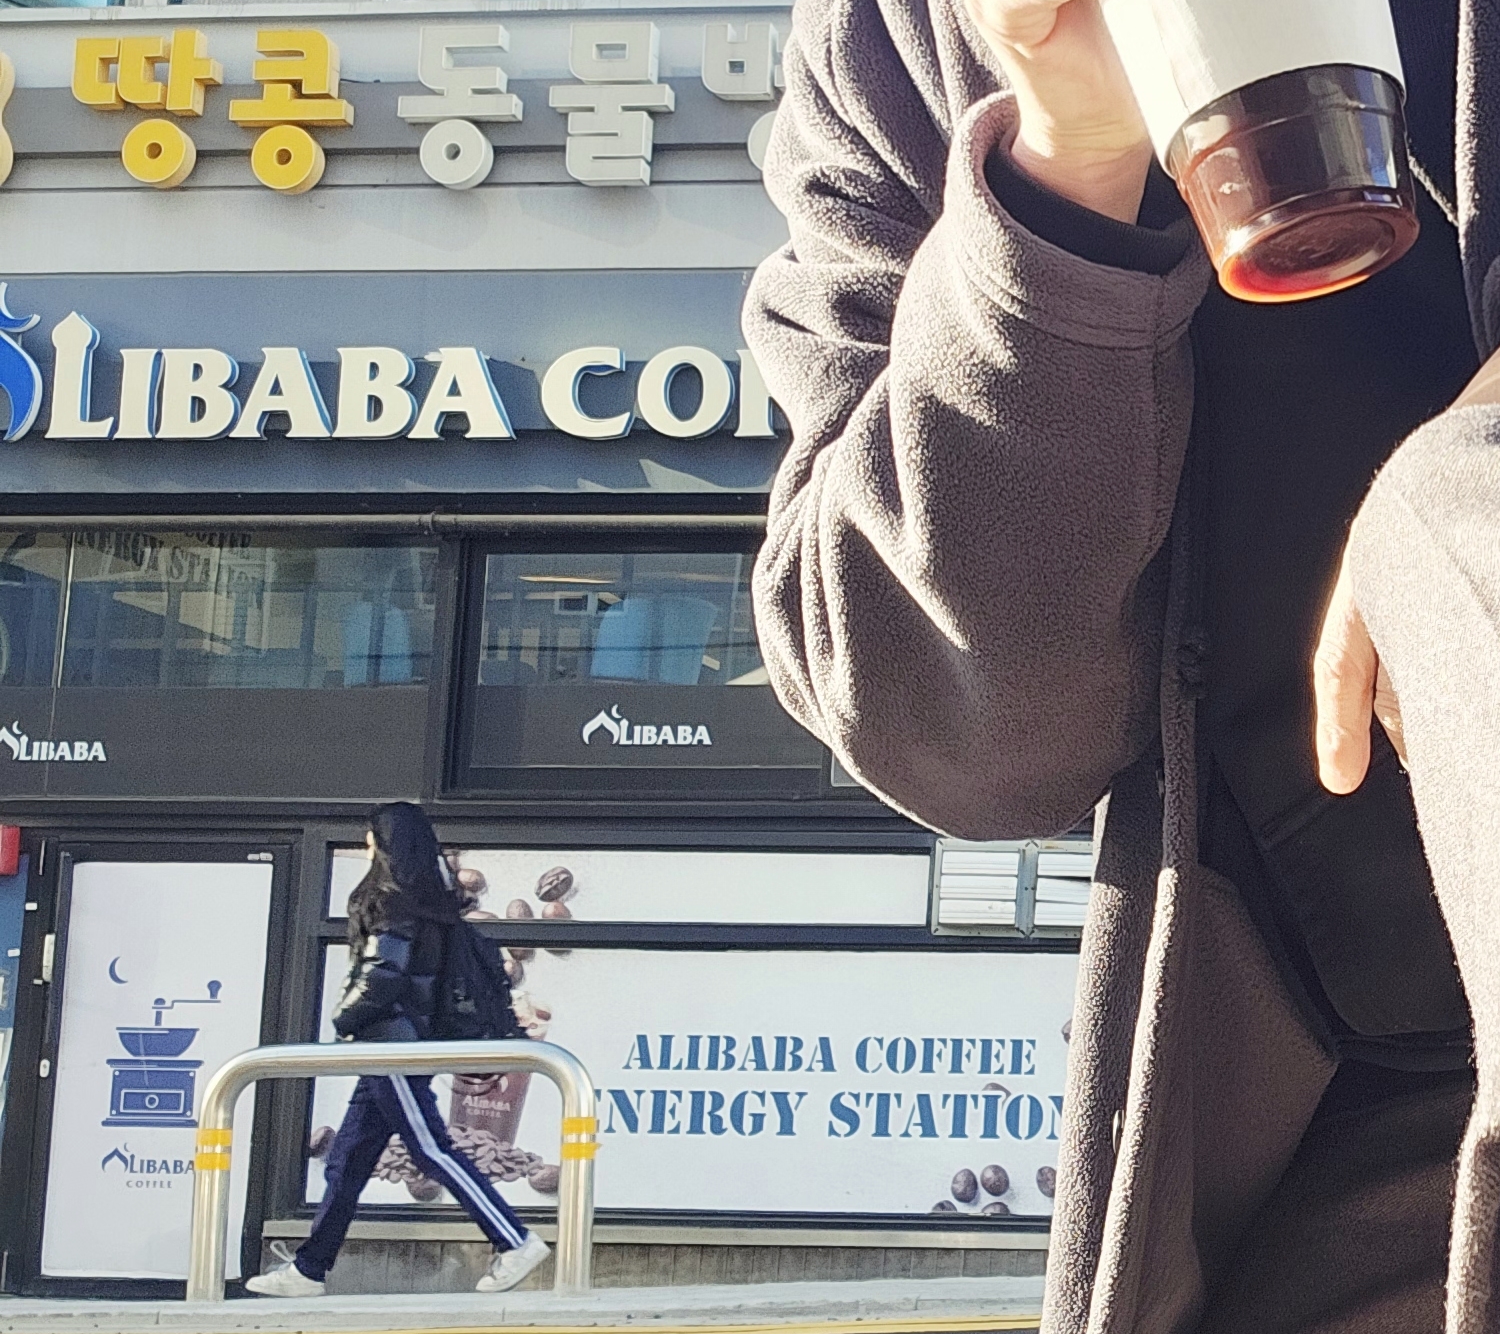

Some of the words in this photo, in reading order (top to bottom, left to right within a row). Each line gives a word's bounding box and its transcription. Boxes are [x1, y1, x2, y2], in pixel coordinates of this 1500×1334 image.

[71, 29, 355, 195] 땅콩
[622, 1033, 838, 1073] ALIBABA
[855, 1036, 1037, 1076] COFFEE
[594, 1088, 809, 1137] NERGY
